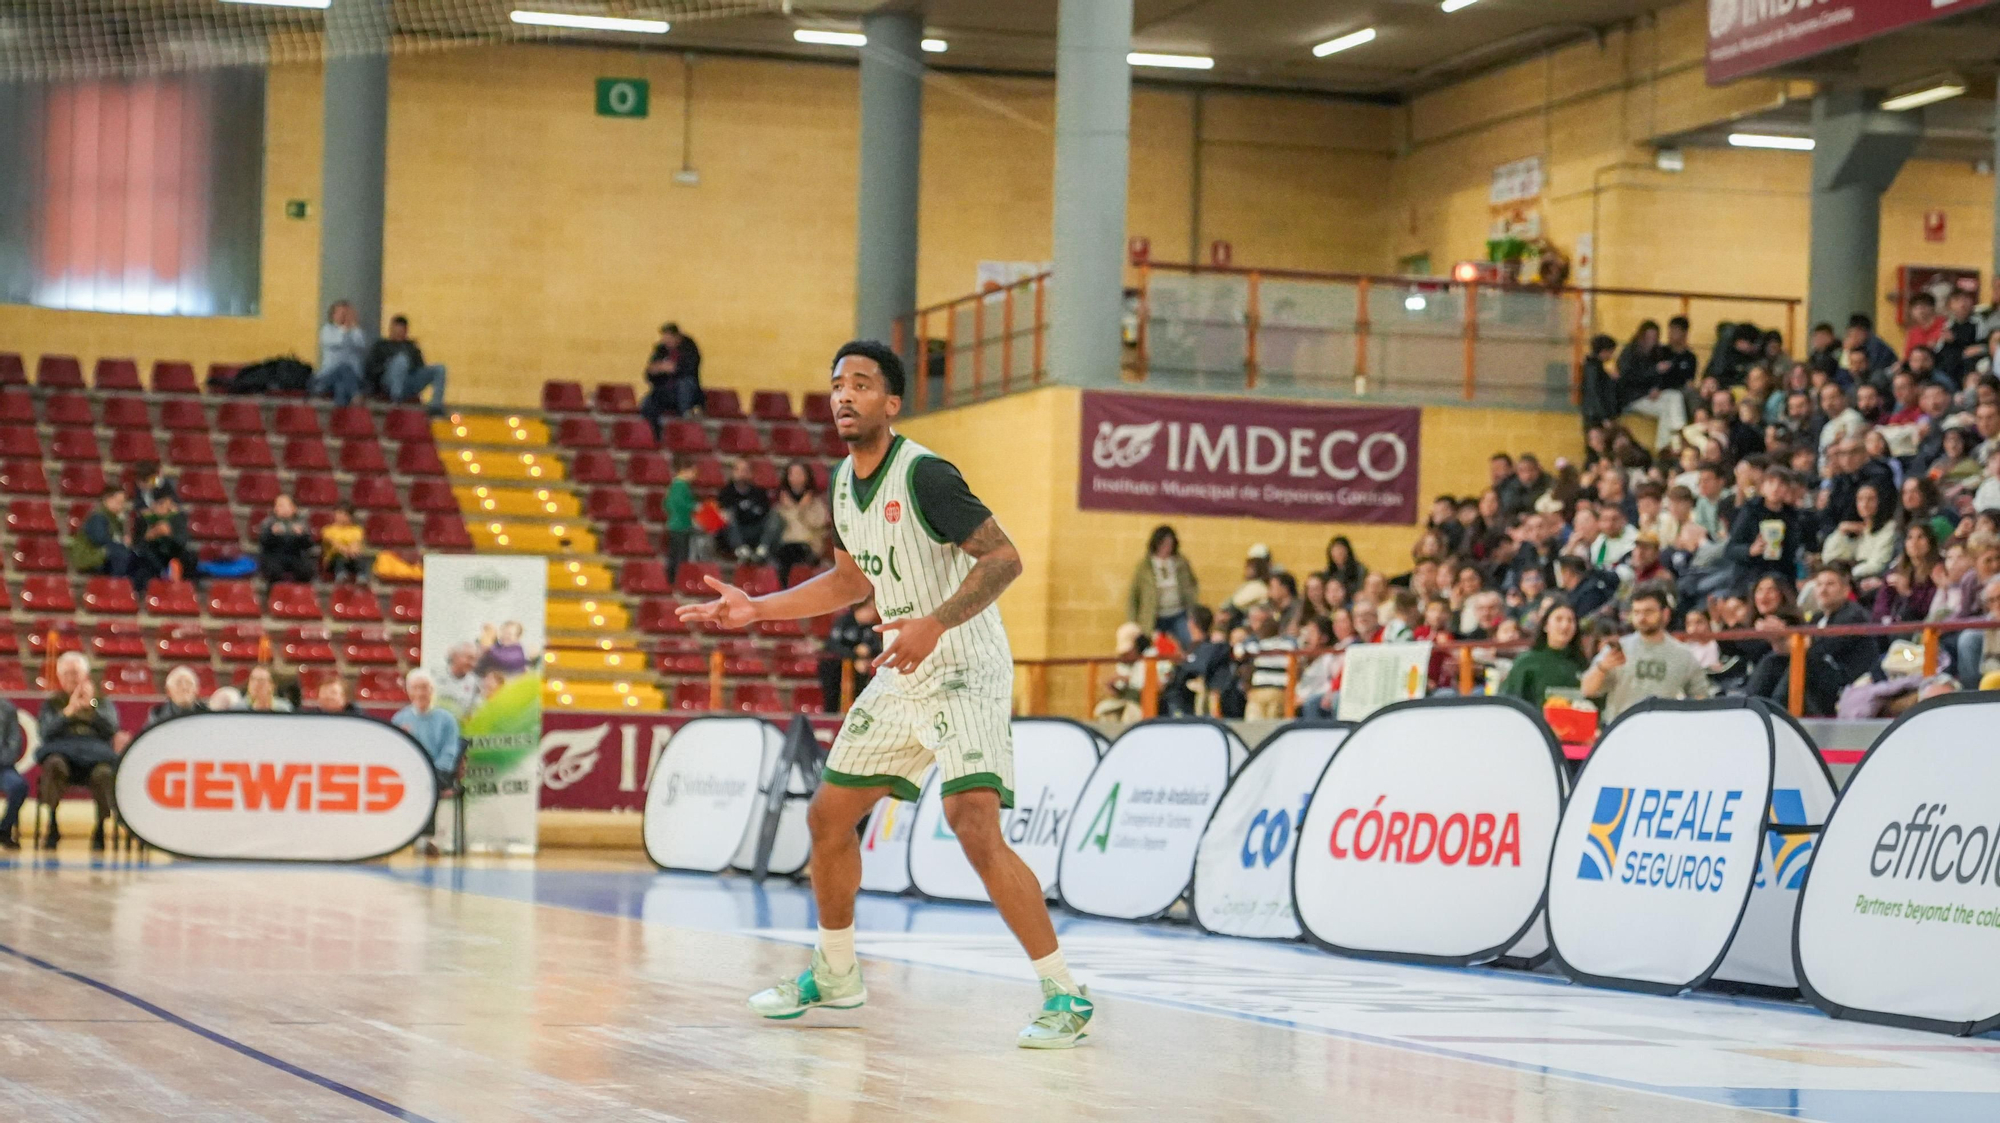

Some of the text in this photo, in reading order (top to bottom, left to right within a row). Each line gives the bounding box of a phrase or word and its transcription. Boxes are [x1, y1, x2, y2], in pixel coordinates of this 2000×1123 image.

[1165, 420, 1408, 482] IMDECO
[1329, 795, 1520, 867] CÓRDOBA
[1633, 790, 1743, 842] REALE
[1621, 850, 1726, 892] SEGUROS
[1854, 894, 1903, 918] Partners
[1904, 899, 1953, 925] beyond
[1953, 904, 1974, 925] the
